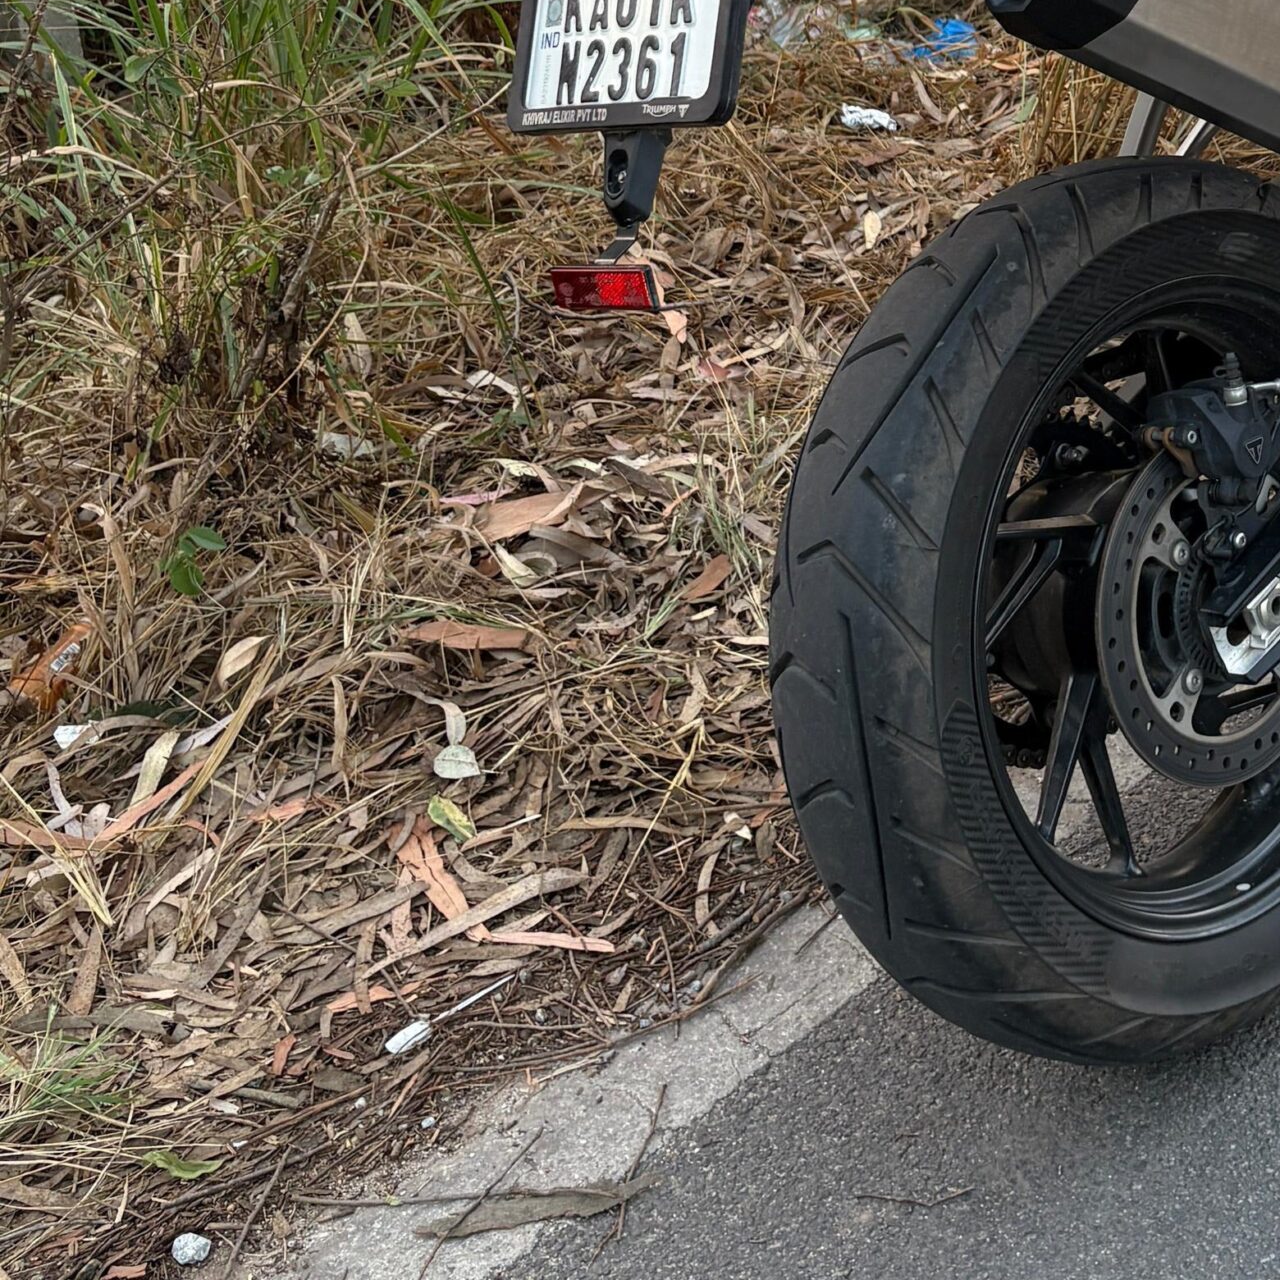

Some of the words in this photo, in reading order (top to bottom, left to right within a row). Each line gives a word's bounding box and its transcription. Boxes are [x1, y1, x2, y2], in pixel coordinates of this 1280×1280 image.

[541, 32, 560, 49] IND
[556, 31, 687, 105] N2361
[522, 111, 552, 126] KHIVRAJ
[576, 108, 592, 122] PVT
[592, 108, 607, 122] LTD
[642, 104, 677, 117] TRIUMPH
